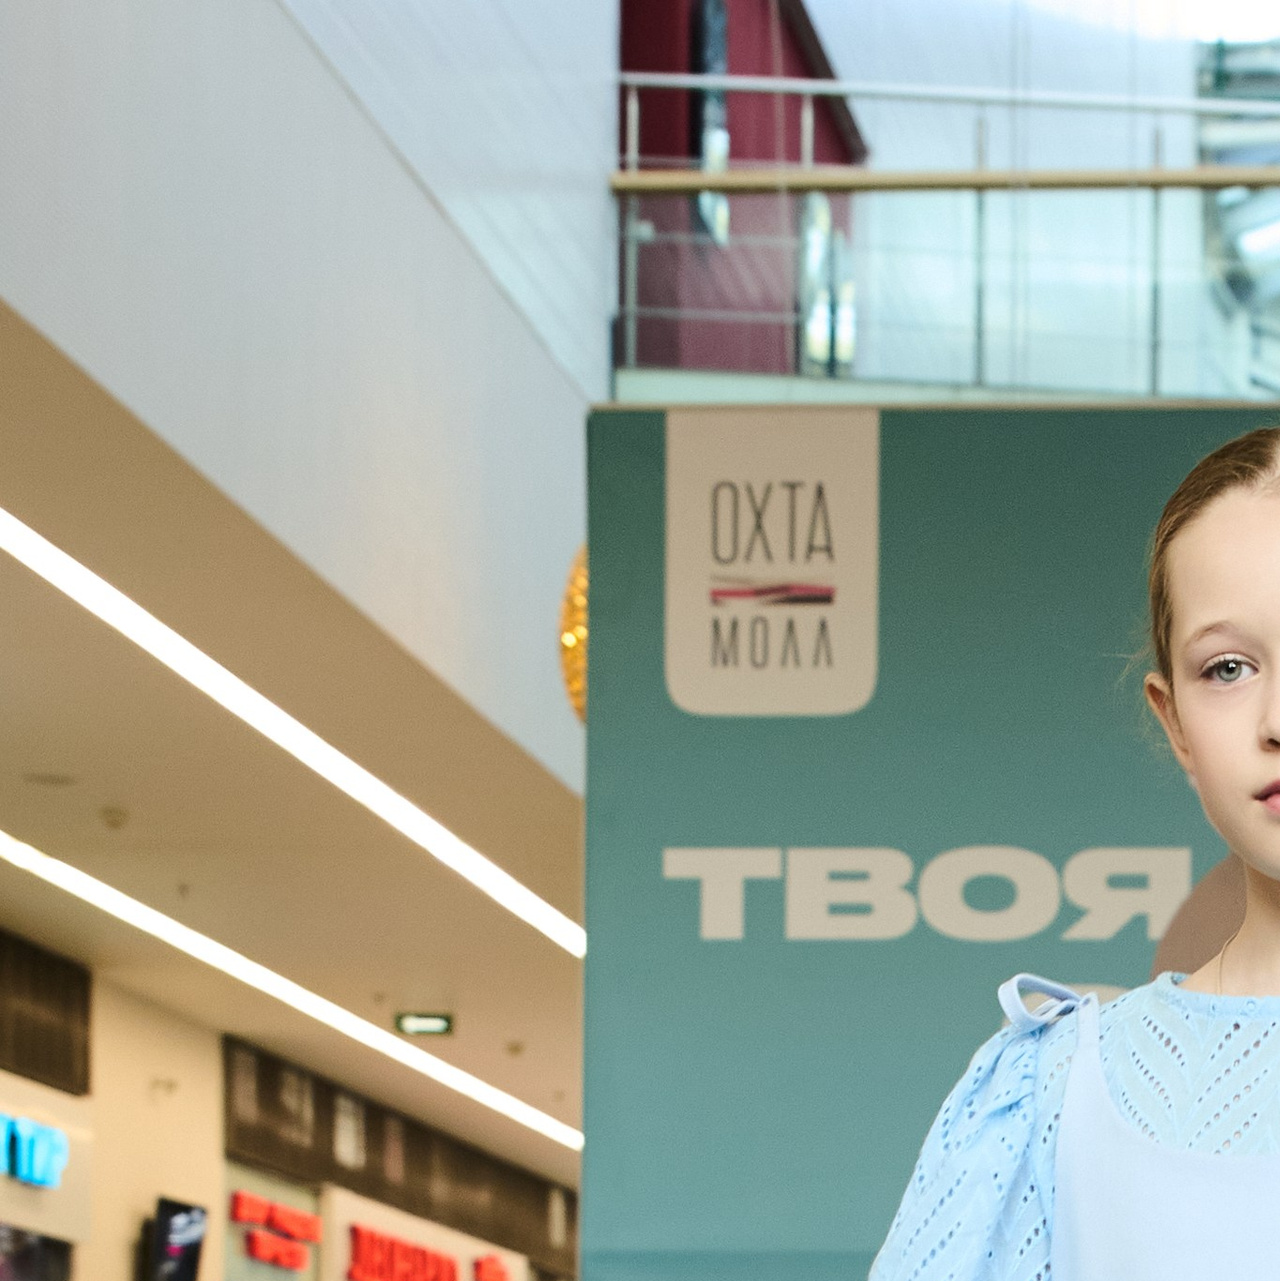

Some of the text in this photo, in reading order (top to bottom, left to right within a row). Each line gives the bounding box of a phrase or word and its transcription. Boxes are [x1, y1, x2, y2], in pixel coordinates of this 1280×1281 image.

[709, 481, 836, 564] ОХТА
[709, 617, 834, 669] МОЛЛ
[662, 846, 1192, 941] ТВОЯ
